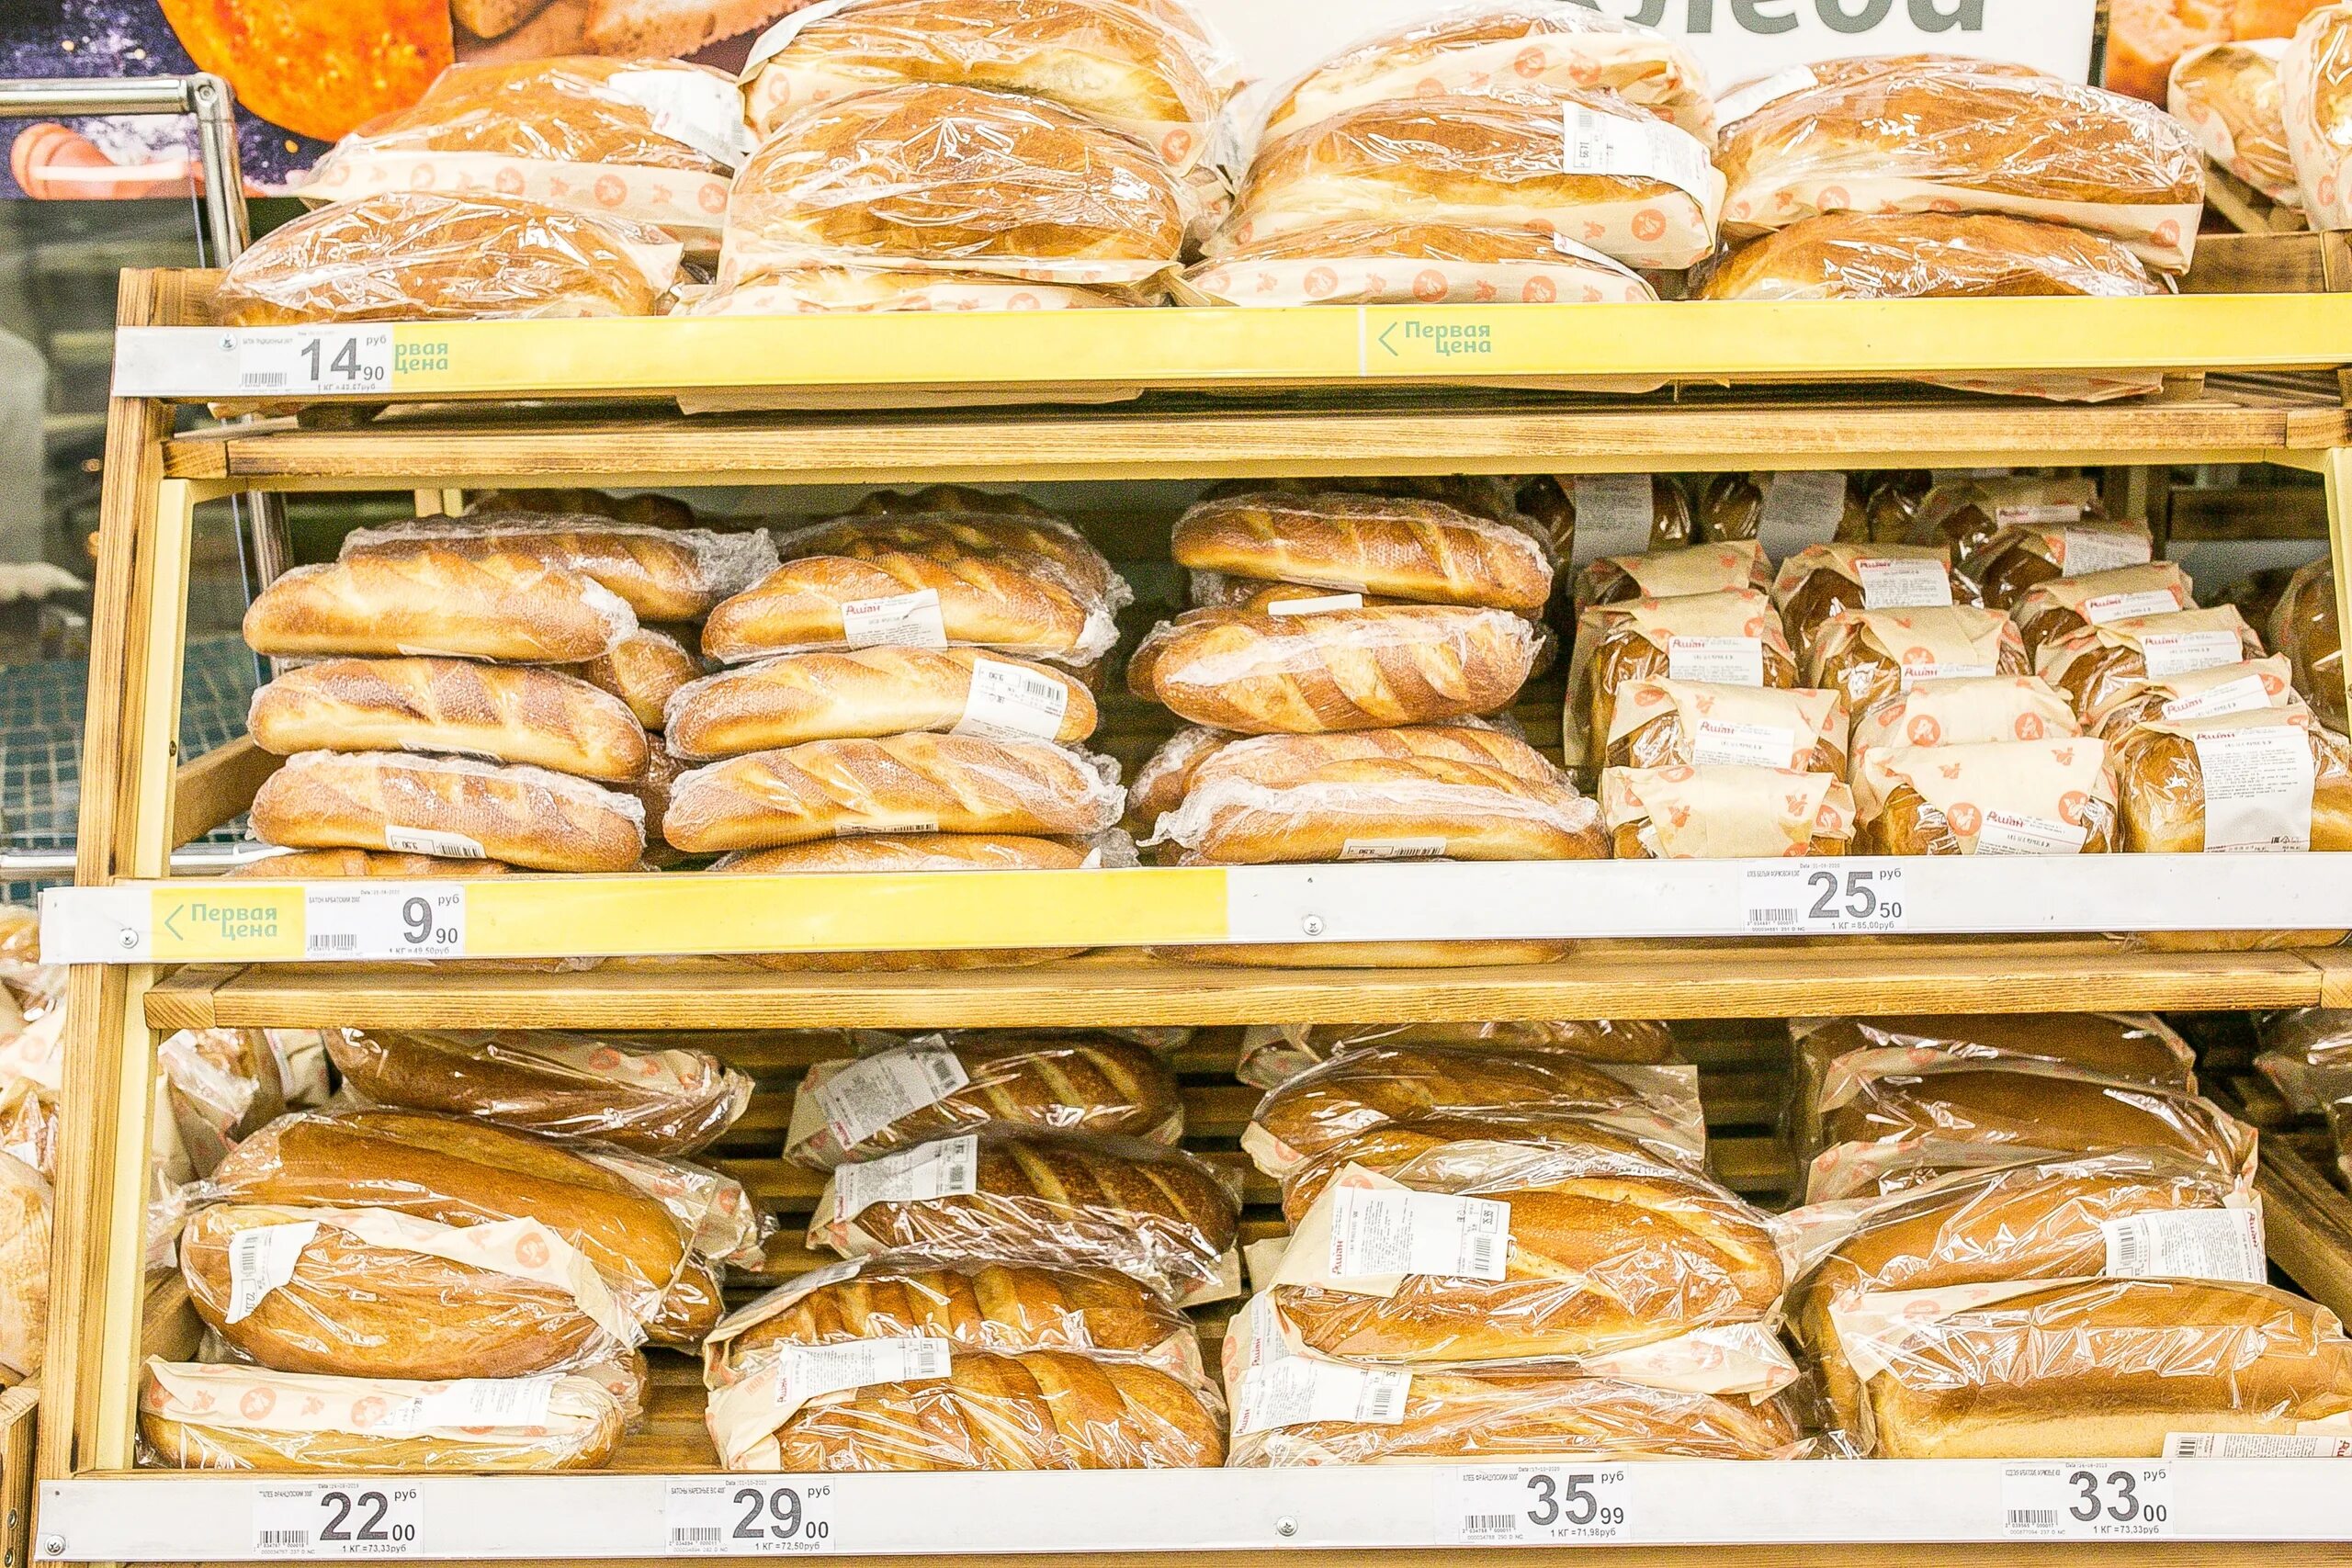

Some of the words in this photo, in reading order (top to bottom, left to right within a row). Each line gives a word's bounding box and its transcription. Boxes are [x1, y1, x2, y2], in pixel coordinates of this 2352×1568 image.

[366, 333, 387, 346] руб
[1405, 321, 1490, 341] Первая
[394, 342, 448, 357] рвая
[1435, 339, 1492, 356] цена
[300, 337, 361, 380] 14
[363, 367, 385, 380] 90
[1880, 868, 1902, 881] руб
[437, 894, 460, 906] руб
[1807, 871, 1877, 919] 25
[191, 903, 278, 922] Первая
[1880, 902, 1903, 919] 50
[402, 897, 434, 944] 9
[1838, 921, 1849, 930] КГ
[221, 920, 278, 941] цена
[435, 928, 458, 944] 90
[1331, 1240, 1344, 1277] Ашан
[1600, 1471, 1624, 1484] руб
[2143, 1469, 2166, 1482] руб
[394, 1488, 417, 1501] руб
[808, 1485, 831, 1498] руб
[1527, 1474, 1598, 1526] 35
[2069, 1471, 2140, 1522] 33
[320, 1491, 389, 1540] 22
[732, 1487, 802, 1539] 29
[1600, 1506, 1624, 1525] 99
[2143, 1505, 2167, 1522] 00
[392, 1524, 415, 1541] 00
[806, 1521, 829, 1539] 00
[1558, 1529, 1570, 1537] КГ
[2100, 1525, 2112, 1533] КГ
[349, 1544, 361, 1552] КГ
